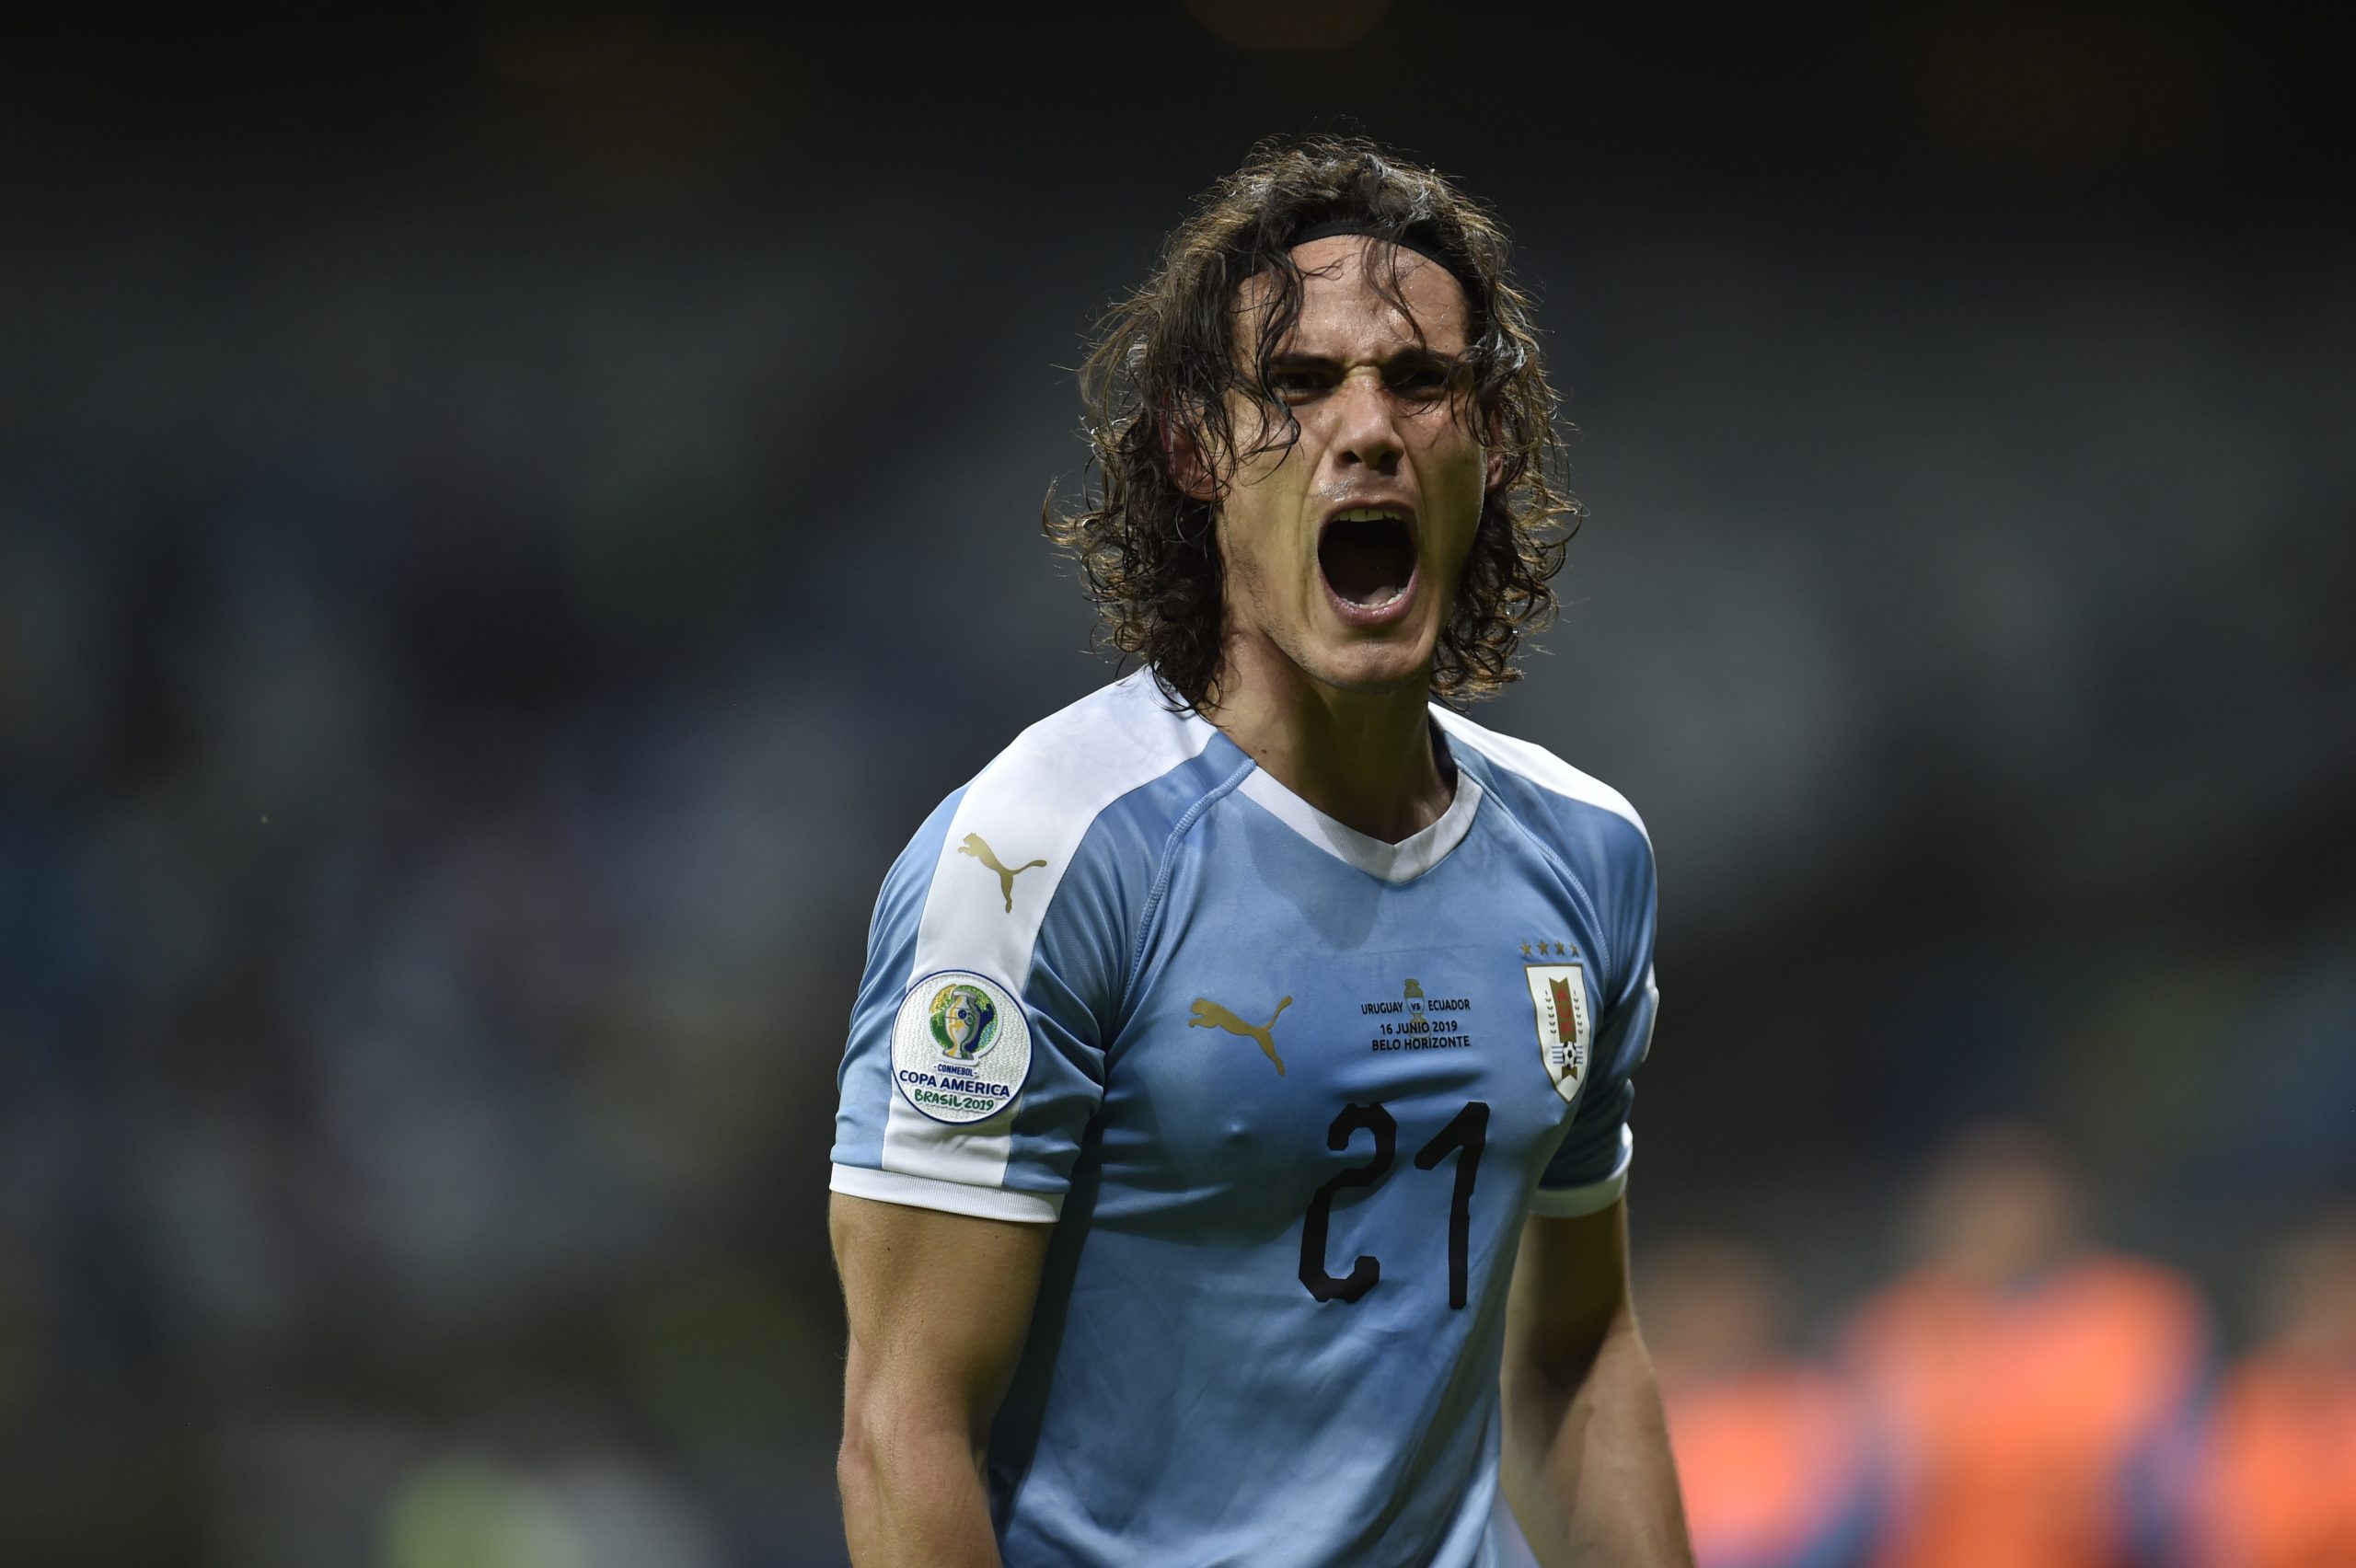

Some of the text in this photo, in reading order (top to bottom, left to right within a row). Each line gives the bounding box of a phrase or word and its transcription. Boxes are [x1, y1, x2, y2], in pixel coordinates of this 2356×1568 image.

[1361, 1002, 1403, 1014] URUGUAY
[1427, 998, 1471, 1011] ECUADOR
[1380, 1020, 1458, 1035] 16 JUNIO 2019
[1371, 1035, 1471, 1051] BELO HORIZONTE
[899, 1069, 1011, 1098] COPA AMERICA
[962, 1097, 995, 1112] 2019
[1299, 1101, 1490, 1309] 21
